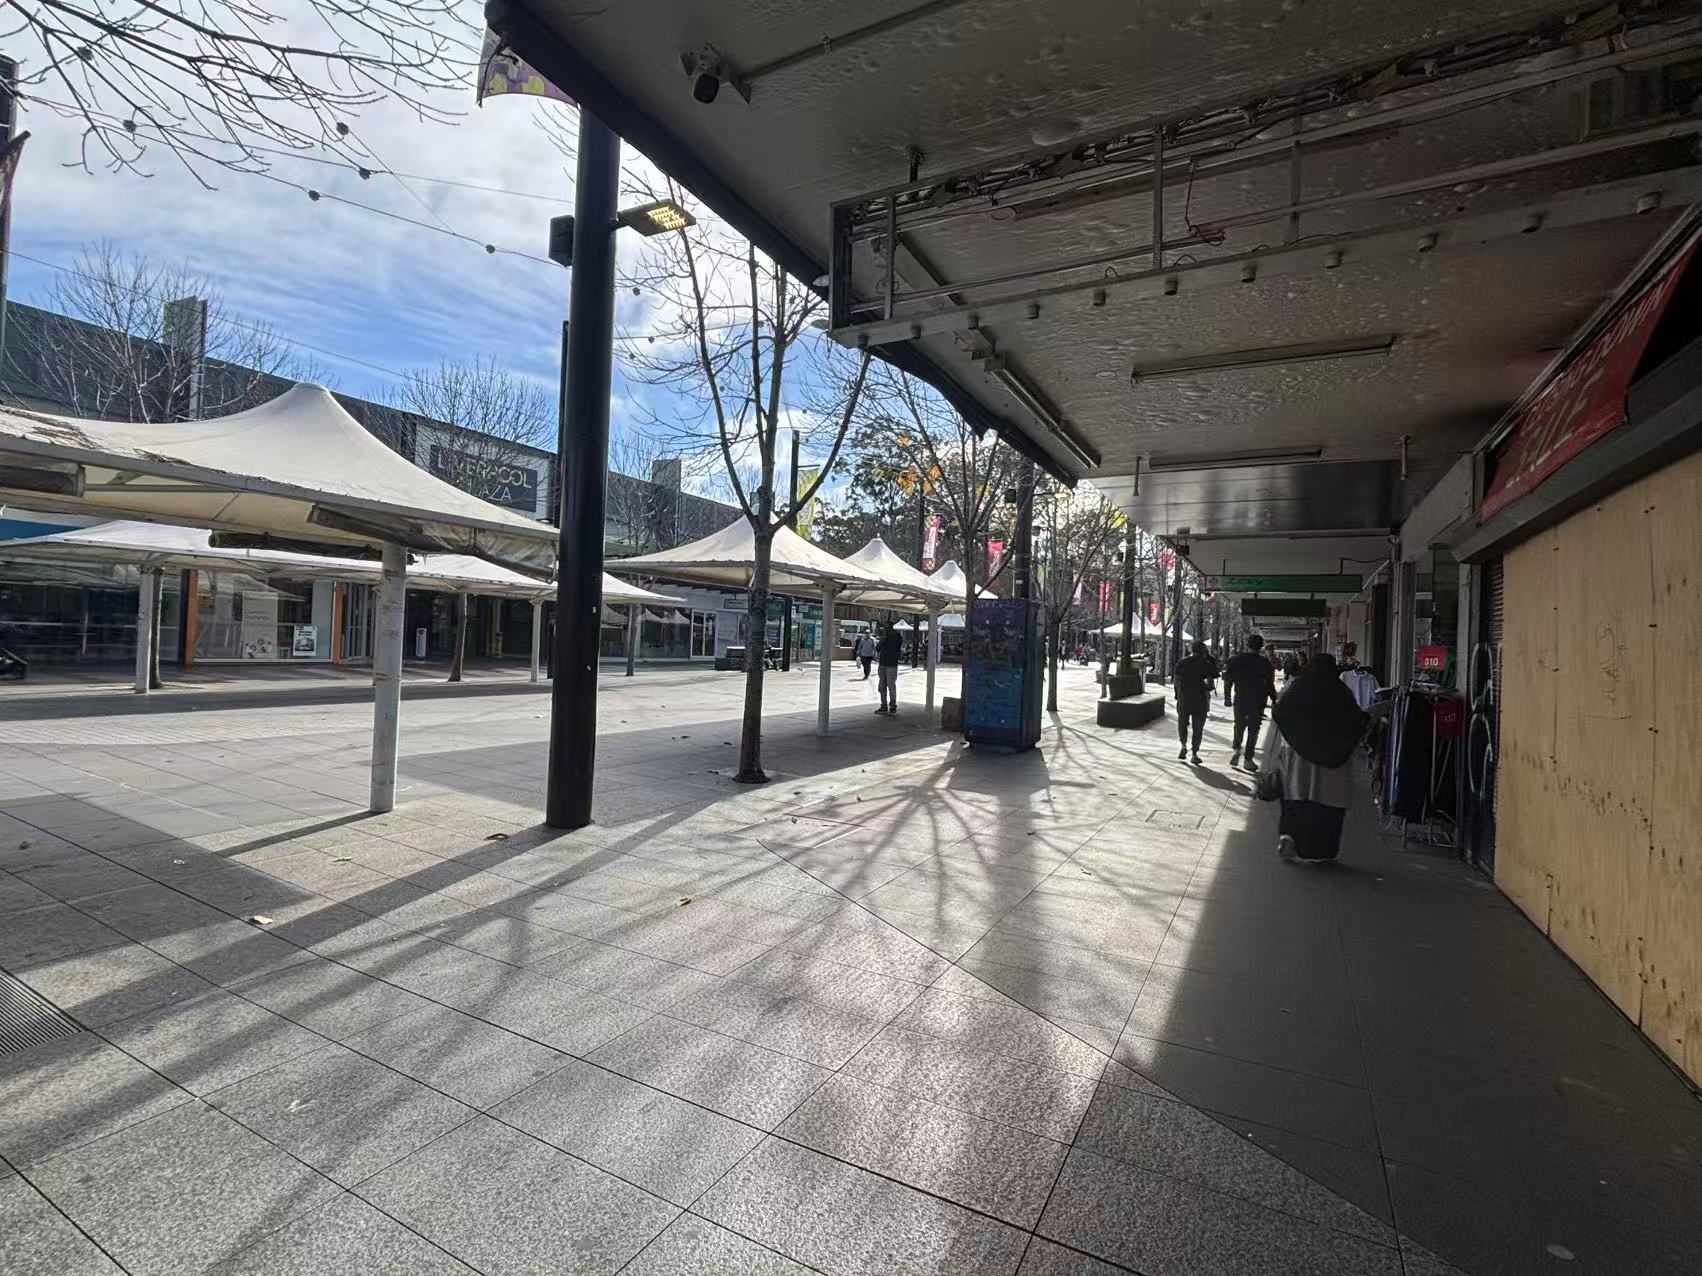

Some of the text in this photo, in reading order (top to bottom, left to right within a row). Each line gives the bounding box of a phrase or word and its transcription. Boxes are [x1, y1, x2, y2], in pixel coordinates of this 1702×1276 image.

[438, 449, 532, 488] LVERPOOL
[468, 478, 512, 504] AZA
[1424, 657, 1439, 666] $10
